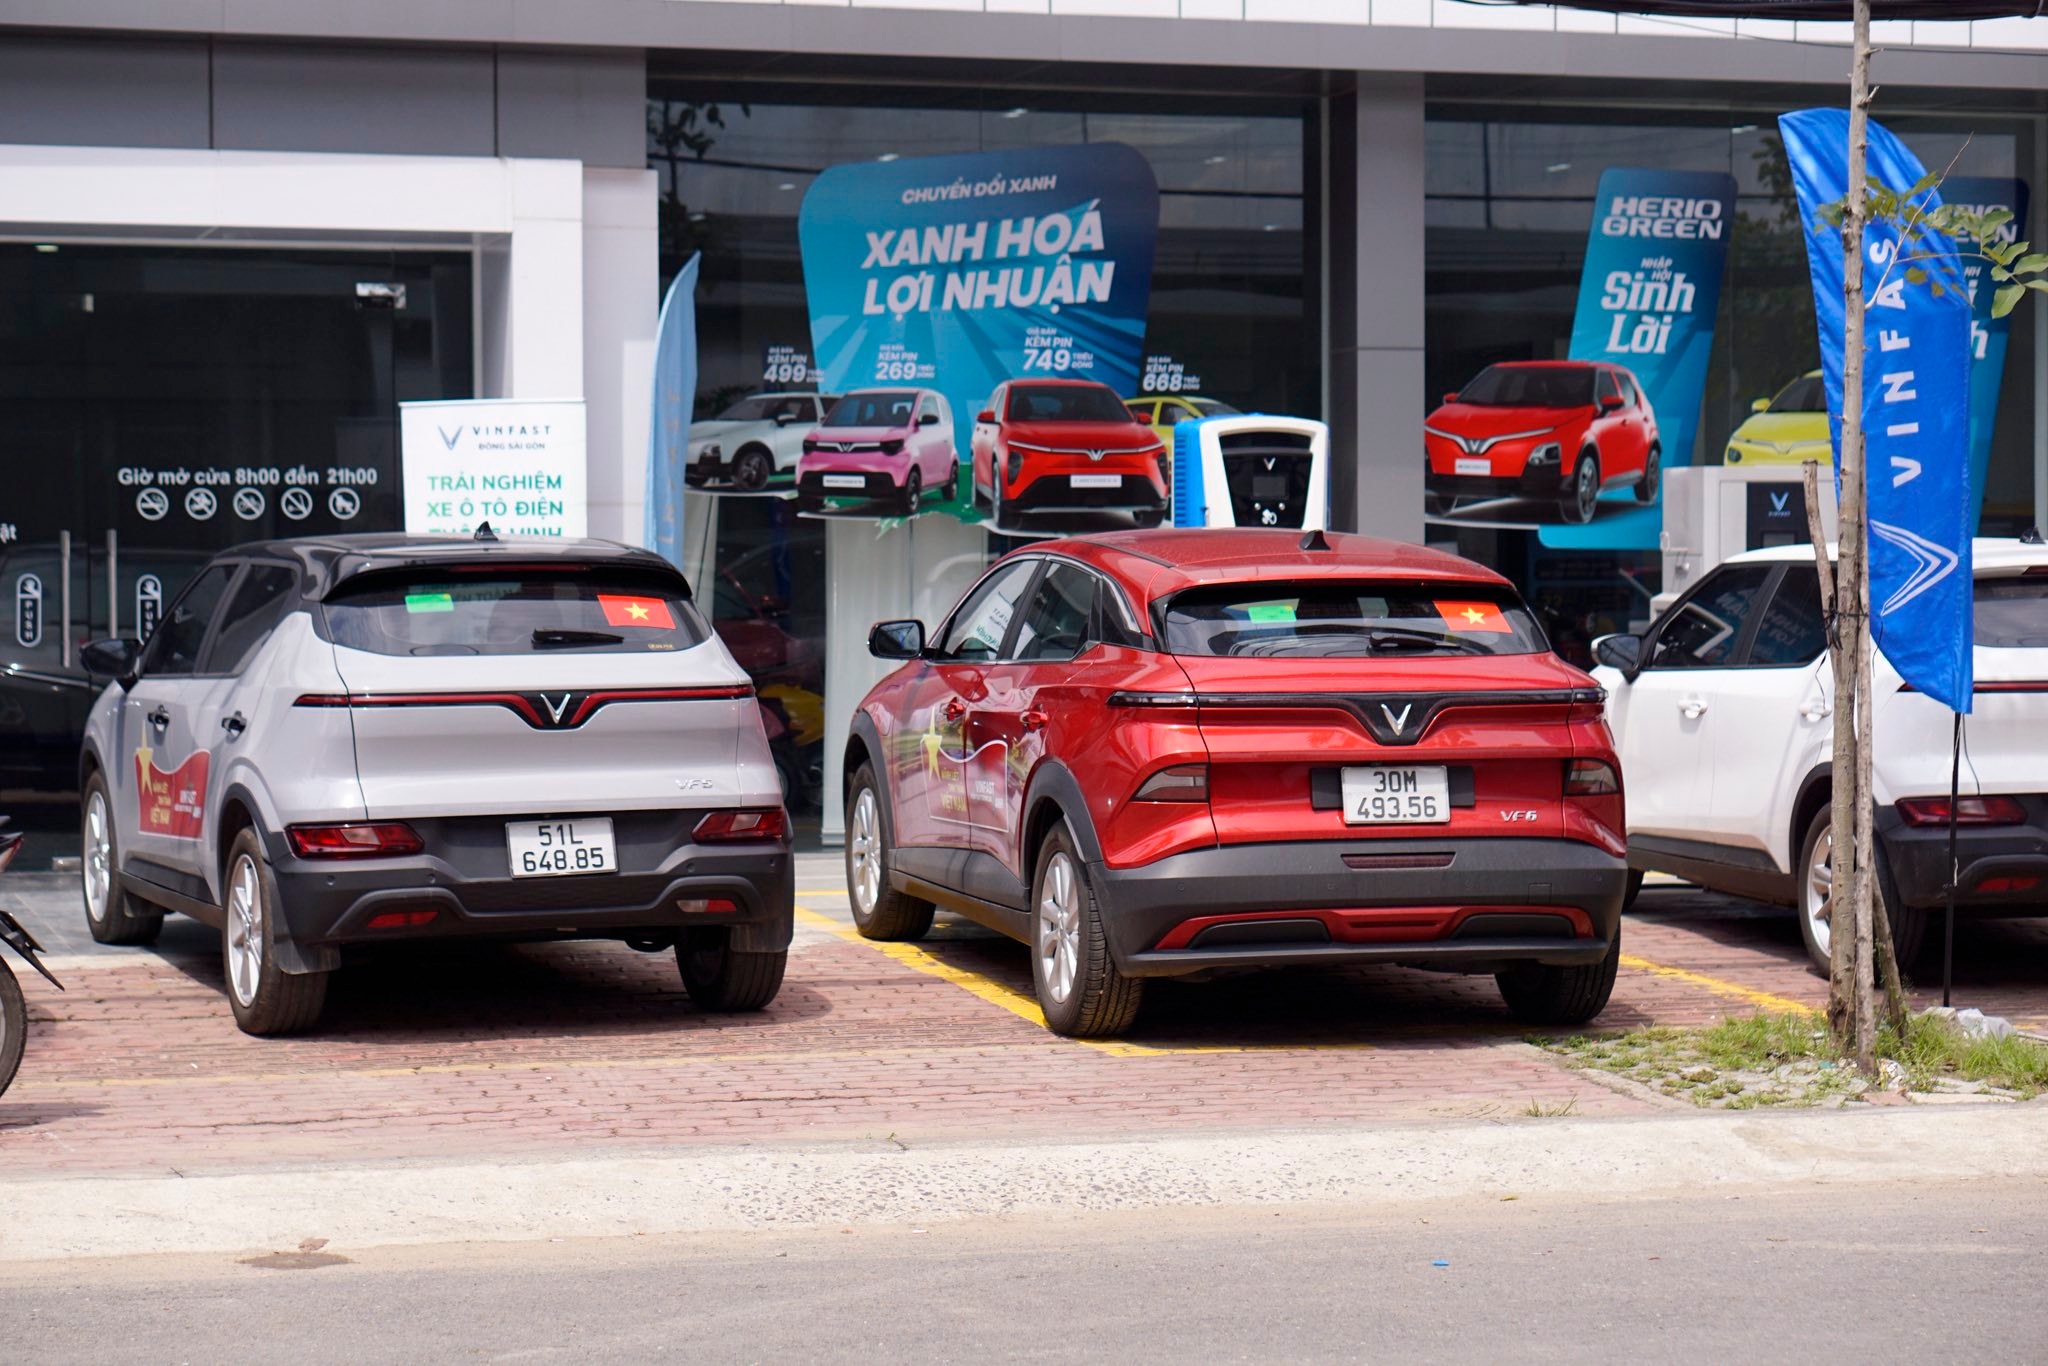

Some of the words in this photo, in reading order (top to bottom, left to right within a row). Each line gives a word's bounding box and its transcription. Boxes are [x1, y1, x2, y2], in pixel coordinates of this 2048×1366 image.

[902, 176, 971, 204] CHUYỂN
[974, 172, 1006, 198] ĐỔI
[1009, 175, 1057, 194] XANH
[1611, 196, 1722, 220] HERIO
[861, 221, 988, 269] XANH
[996, 198, 1104, 259] HOÁ
[1602, 215, 1723, 239] GREEN
[863, 270, 935, 321] LỢI
[942, 254, 1116, 314] NHUẬN
[1601, 270, 1696, 312] Sinh
[1053, 336, 1073, 347] PIN
[1605, 313, 1673, 354] Lời
[790, 354, 807, 364] PIN
[901, 352, 918, 361] PIN
[1023, 348, 1071, 371] 749
[1168, 363, 1184, 373] PIN
[1869, 238, 1922, 488] VINFAS
[763, 364, 807, 383] 499
[875, 362, 917, 380] 269
[1142, 373, 1183, 392] 668
[473, 425, 551, 435] VINFAST
[118, 466, 154, 486] Giờ
[158, 467, 191, 485] mở
[194, 466, 231, 485] cửa
[235, 467, 280, 485] 8h00
[284, 465, 319, 485] đến
[327, 467, 378, 485] 21h00
[427, 471, 475, 491] TRẢI
[482, 470, 562, 494] NGHIỆM
[427, 502, 452, 517] XE
[460, 497, 474, 516] Ô
[481, 497, 507, 516] TÔ
[515, 496, 563, 520] ĐIỆN
[24, 601, 34, 640] PUSH
[1373, 770, 1417, 793] 30M
[1357, 795, 1437, 819] 493.56
[1500, 810, 1537, 822] VF6
[538, 823, 583, 846] 51L
[523, 847, 604, 873] 648.85
